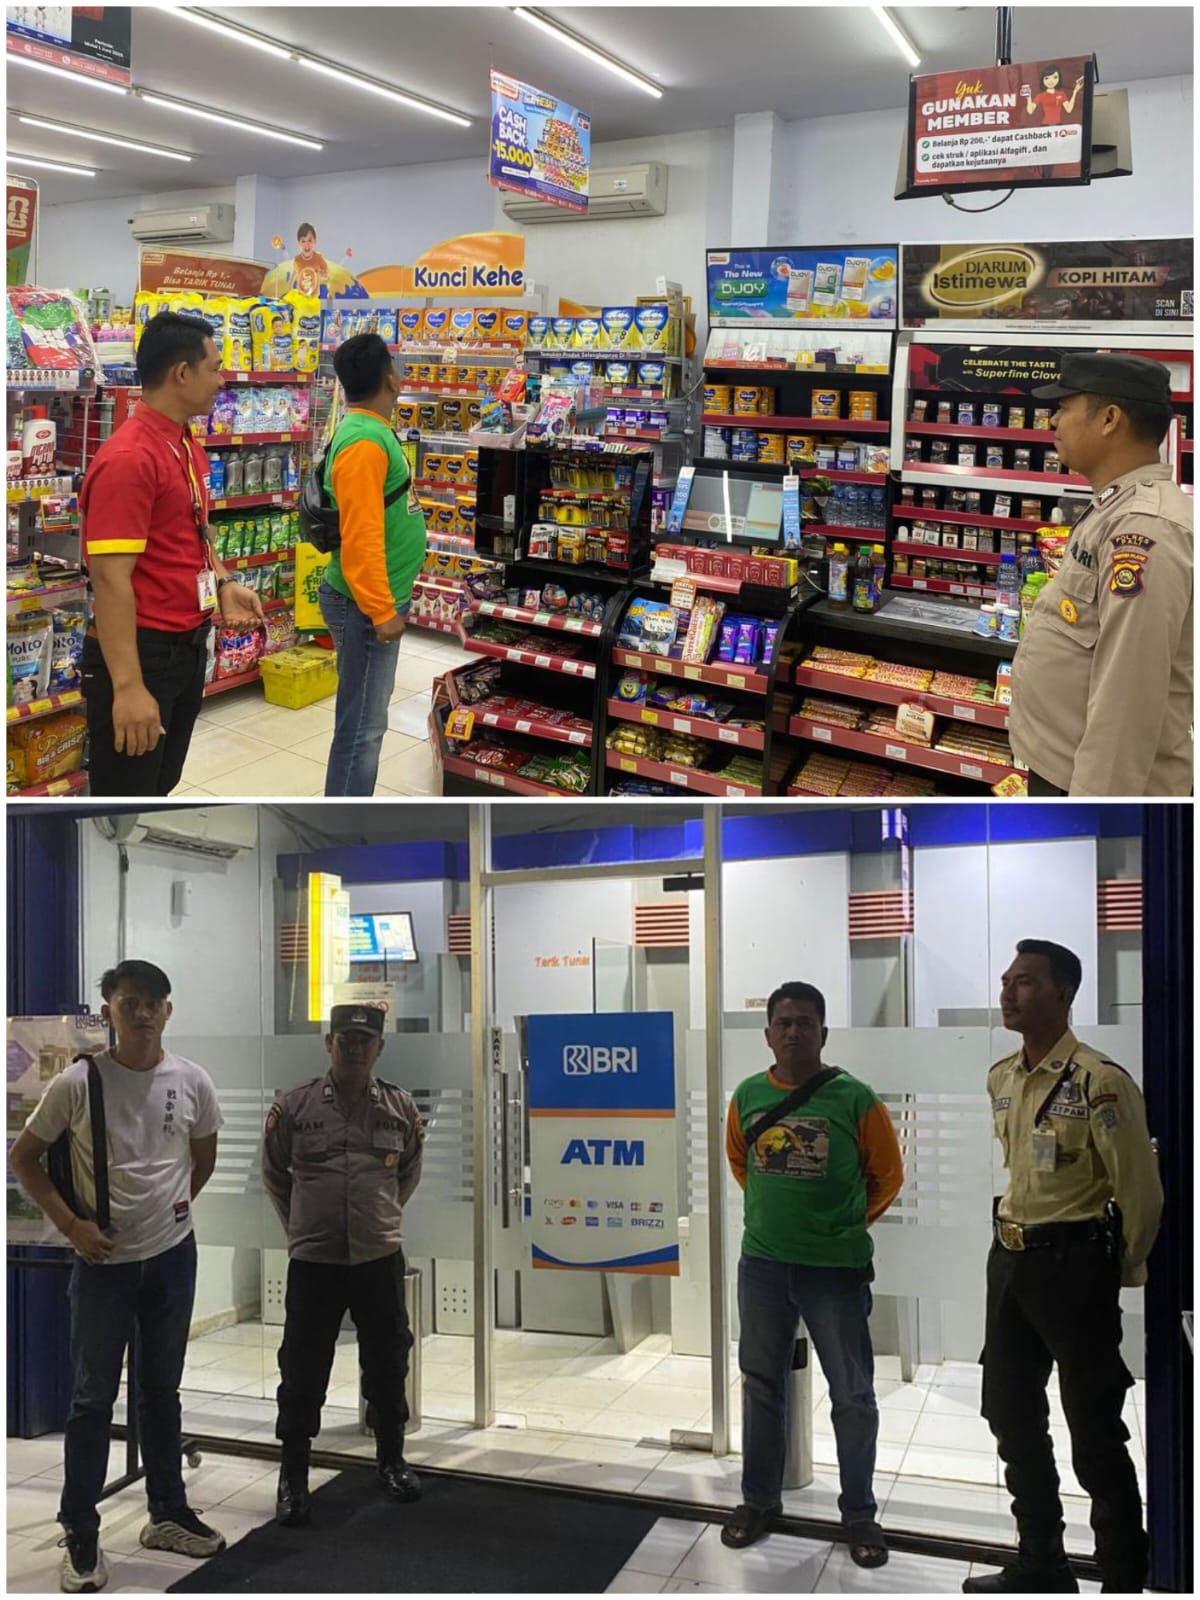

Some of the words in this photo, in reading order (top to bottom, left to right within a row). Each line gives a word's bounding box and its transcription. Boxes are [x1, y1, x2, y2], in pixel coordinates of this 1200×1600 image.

[955, 80, 984, 99] Yuk
[922, 93, 1017, 116] GUNAKAN
[498, 105, 527, 133] CASH
[927, 111, 1010, 131] MEMBER
[499, 123, 527, 147] BACK
[959, 138, 969, 147] Rp
[991, 134, 1014, 144] dapat
[1014, 131, 1052, 141] Cashback
[932, 151, 945, 160] cek
[945, 150, 964, 159] struk
[969, 148, 999, 158] aplikasi
[1032, 144, 1048, 153] dan
[931, 159, 965, 169] dapatkan
[965, 158, 1007, 168] kejutannya
[724, 270, 740, 278] The
[742, 270, 763, 278] New
[966, 261, 1027, 275] DJARUM
[163, 276, 181, 285] Bisa
[183, 278, 208, 287] TARIK
[209, 280, 237, 290] TUNAI
[414, 265, 467, 288] Kunci
[472, 264, 524, 287] Kehe
[933, 272, 1028, 289] Istimewa
[1057, 271, 1097, 284] KOPI
[1102, 270, 1157, 284] HITAM
[721, 283, 765, 295] DJOY
[1155, 299, 1175, 308] SCAN
[1155, 308, 1164, 317] DI
[963, 359, 1009, 367] CELEBRATE
[1010, 360, 1027, 368] THE
[1028, 360, 1056, 369] TASTE
[975, 368, 1030, 381] Superfine
[534, 956, 562, 968] Tarik
[592, 1046, 638, 1073] BRI
[560, 1138, 645, 1166] ATM
[605, 1200, 625, 1209] VISA
[630, 1217, 665, 1229] BRIZZI
